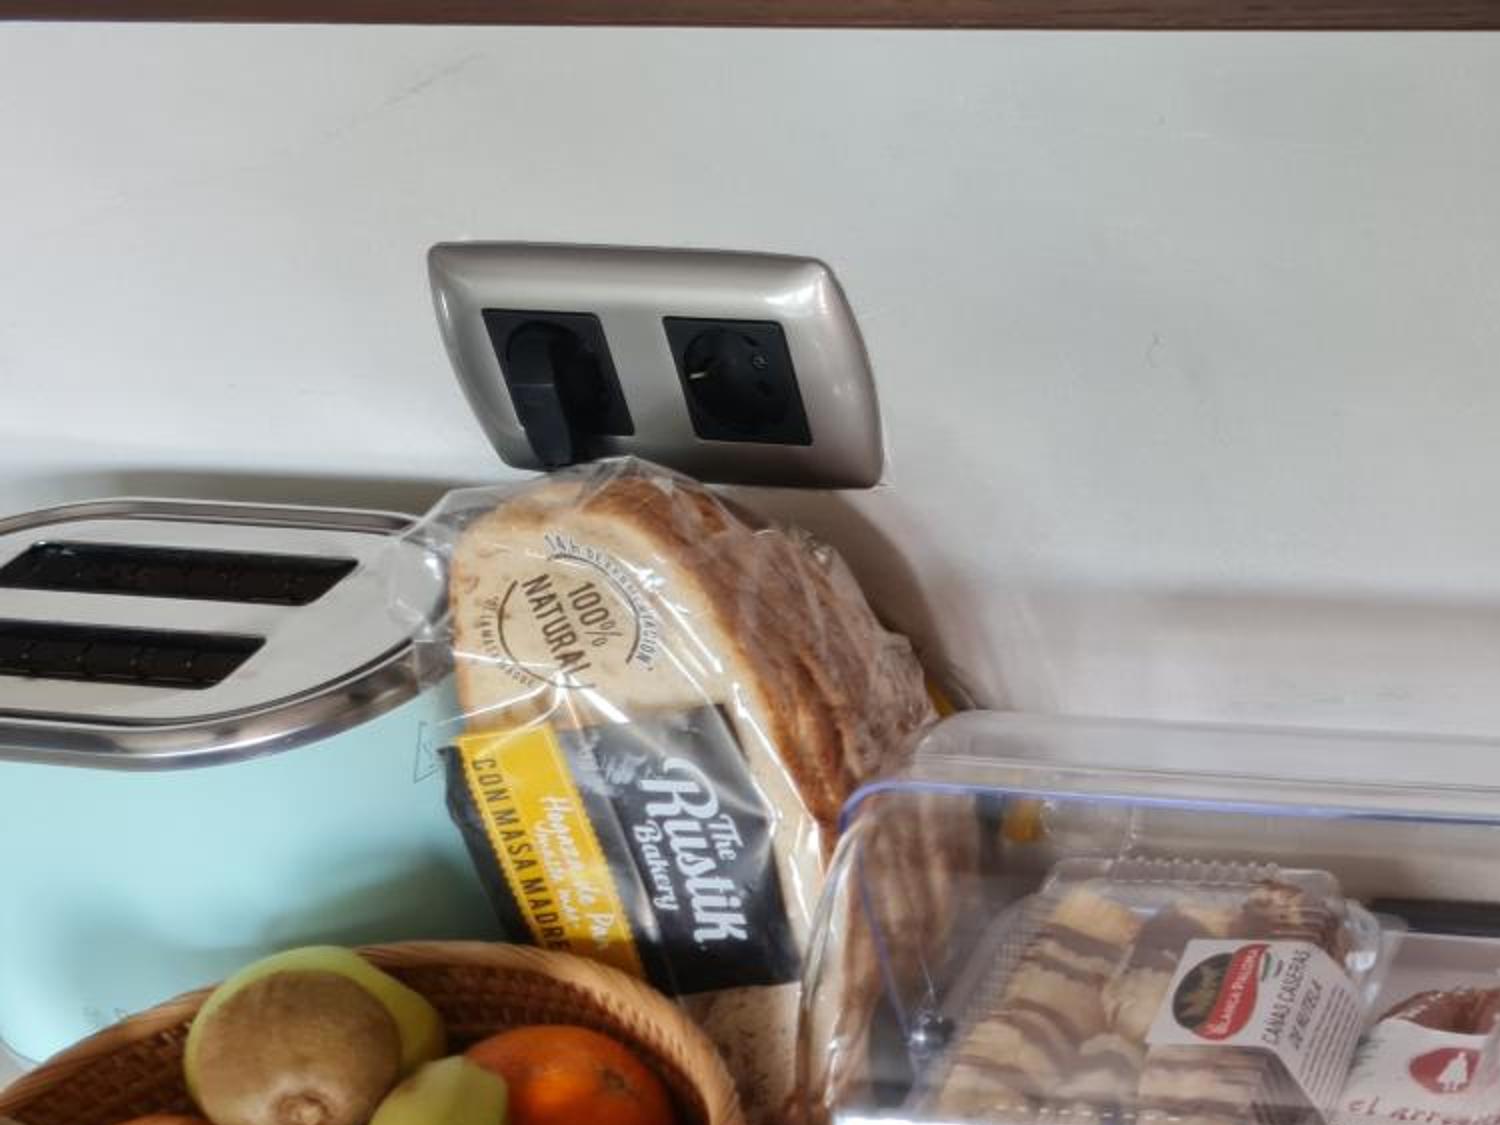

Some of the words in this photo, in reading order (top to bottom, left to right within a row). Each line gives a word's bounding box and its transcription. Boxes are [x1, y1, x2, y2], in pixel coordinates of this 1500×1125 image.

[521, 573, 592, 676] NATURAL
[567, 581, 623, 647] 100%
[472, 757, 511, 803] CON
[494, 808, 537, 871] MASA
[640, 757, 748, 943] Rustik
[708, 813, 745, 861] The
[633, 819, 679, 911] Bakery
